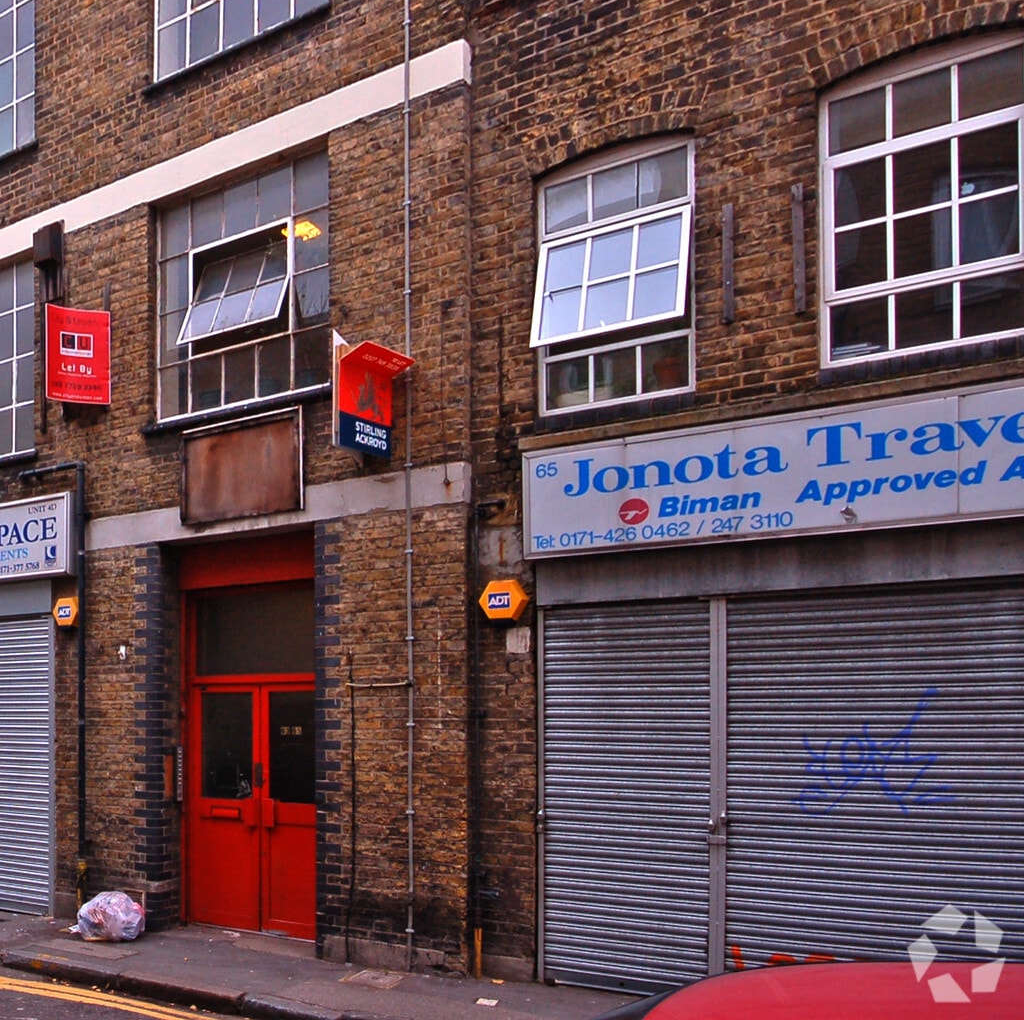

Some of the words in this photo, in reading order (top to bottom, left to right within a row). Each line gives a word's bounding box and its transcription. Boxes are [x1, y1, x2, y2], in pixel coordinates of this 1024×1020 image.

[79, 364, 93, 375] By
[355, 421, 387, 439] STIRLING
[355, 433, 387, 451] ACKROYD
[535, 462, 558, 479] 65
[563, 443, 789, 497] Jonota
[657, 491, 761, 518] Biman
[795, 459, 987, 506] Approved
[28, 505, 46, 515] UNIT
[47, 503, 57, 512] 4D
[559, 526, 637, 548] 0171-426
[641, 521, 690, 539] 0462
[695, 519, 705, 535] /
[711, 516, 744, 534] 247
[750, 511, 794, 530] 3110
[487, 594, 511, 607] ADT
